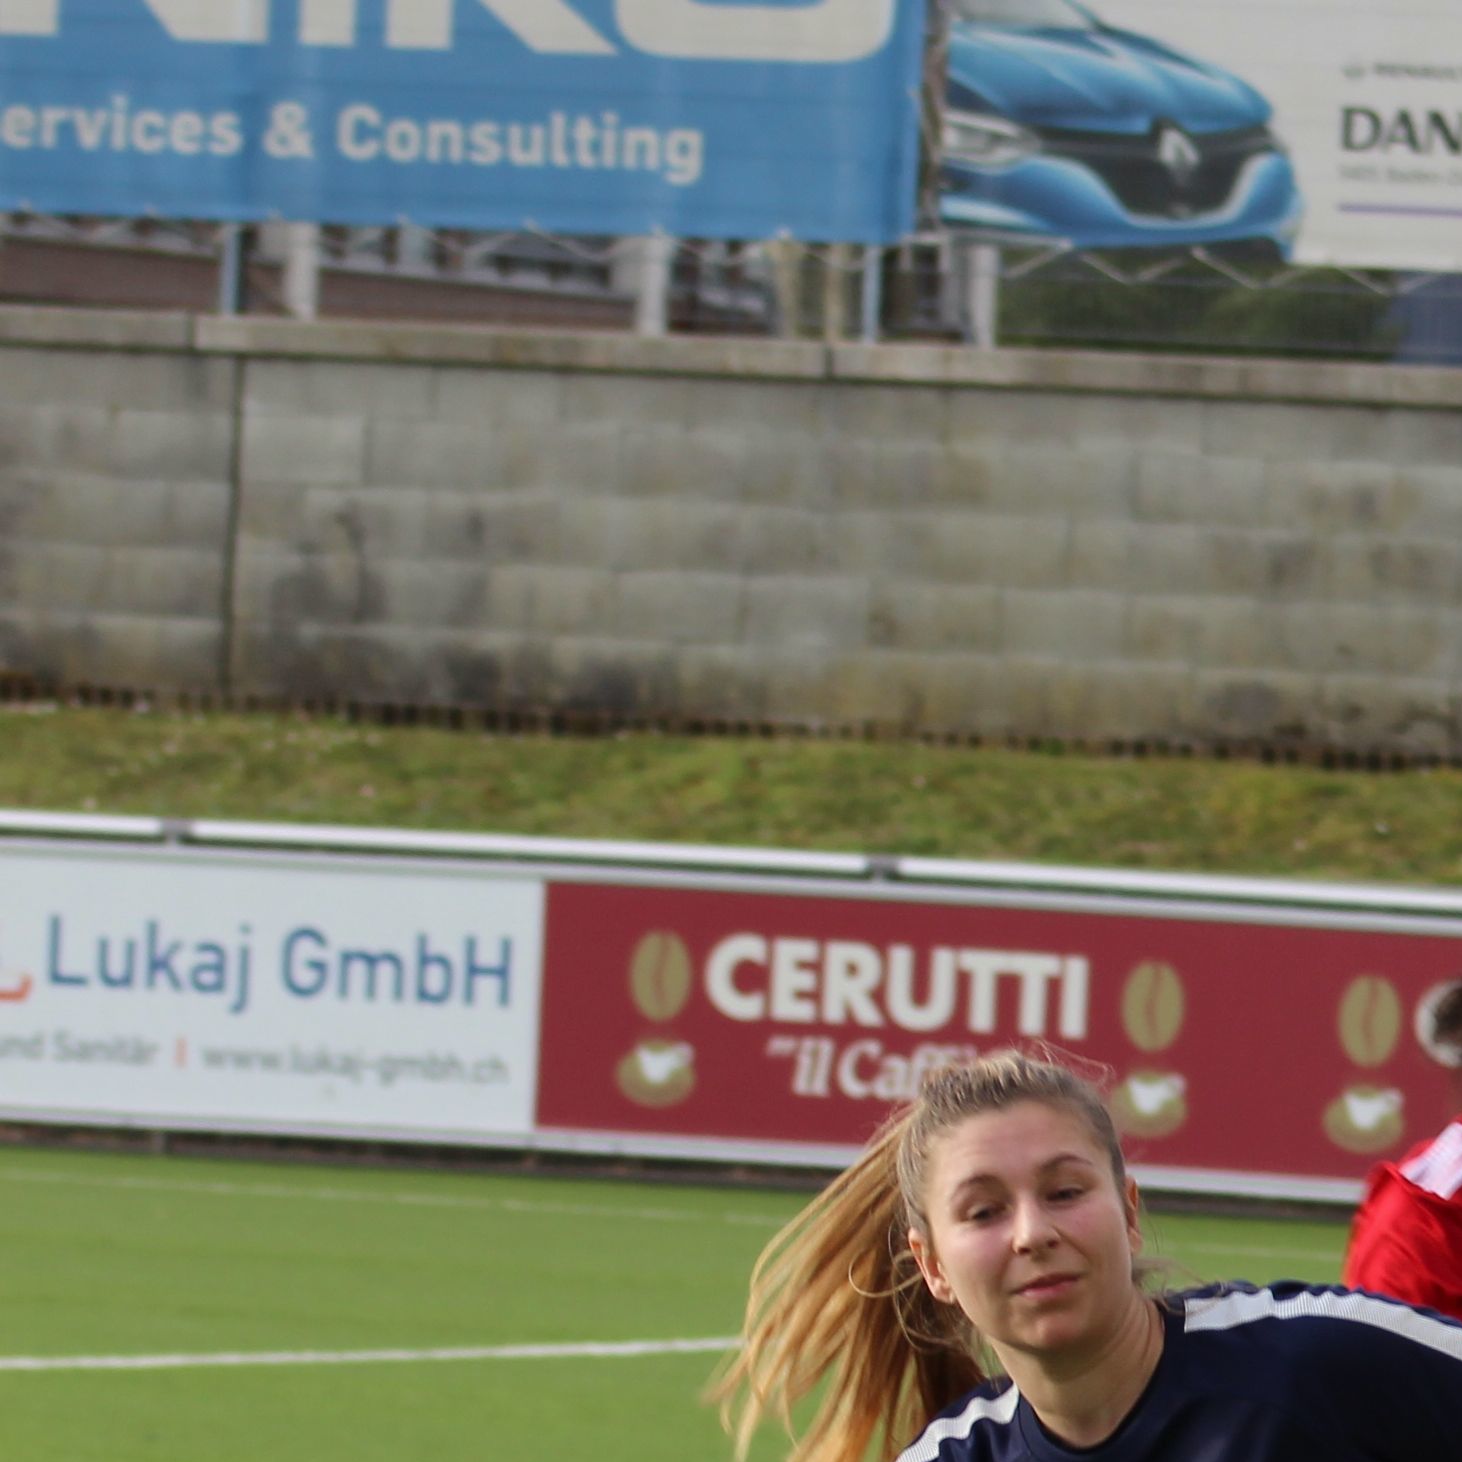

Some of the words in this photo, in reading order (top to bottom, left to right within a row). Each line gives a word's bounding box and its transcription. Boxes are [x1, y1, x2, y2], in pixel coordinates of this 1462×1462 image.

[264, 103, 313, 158] &
[337, 103, 704, 185] Consulting
[47, 914, 253, 1014] Lukaj
[279, 927, 514, 1008] GmbH
[706, 933, 1090, 1039] CERUTTI
